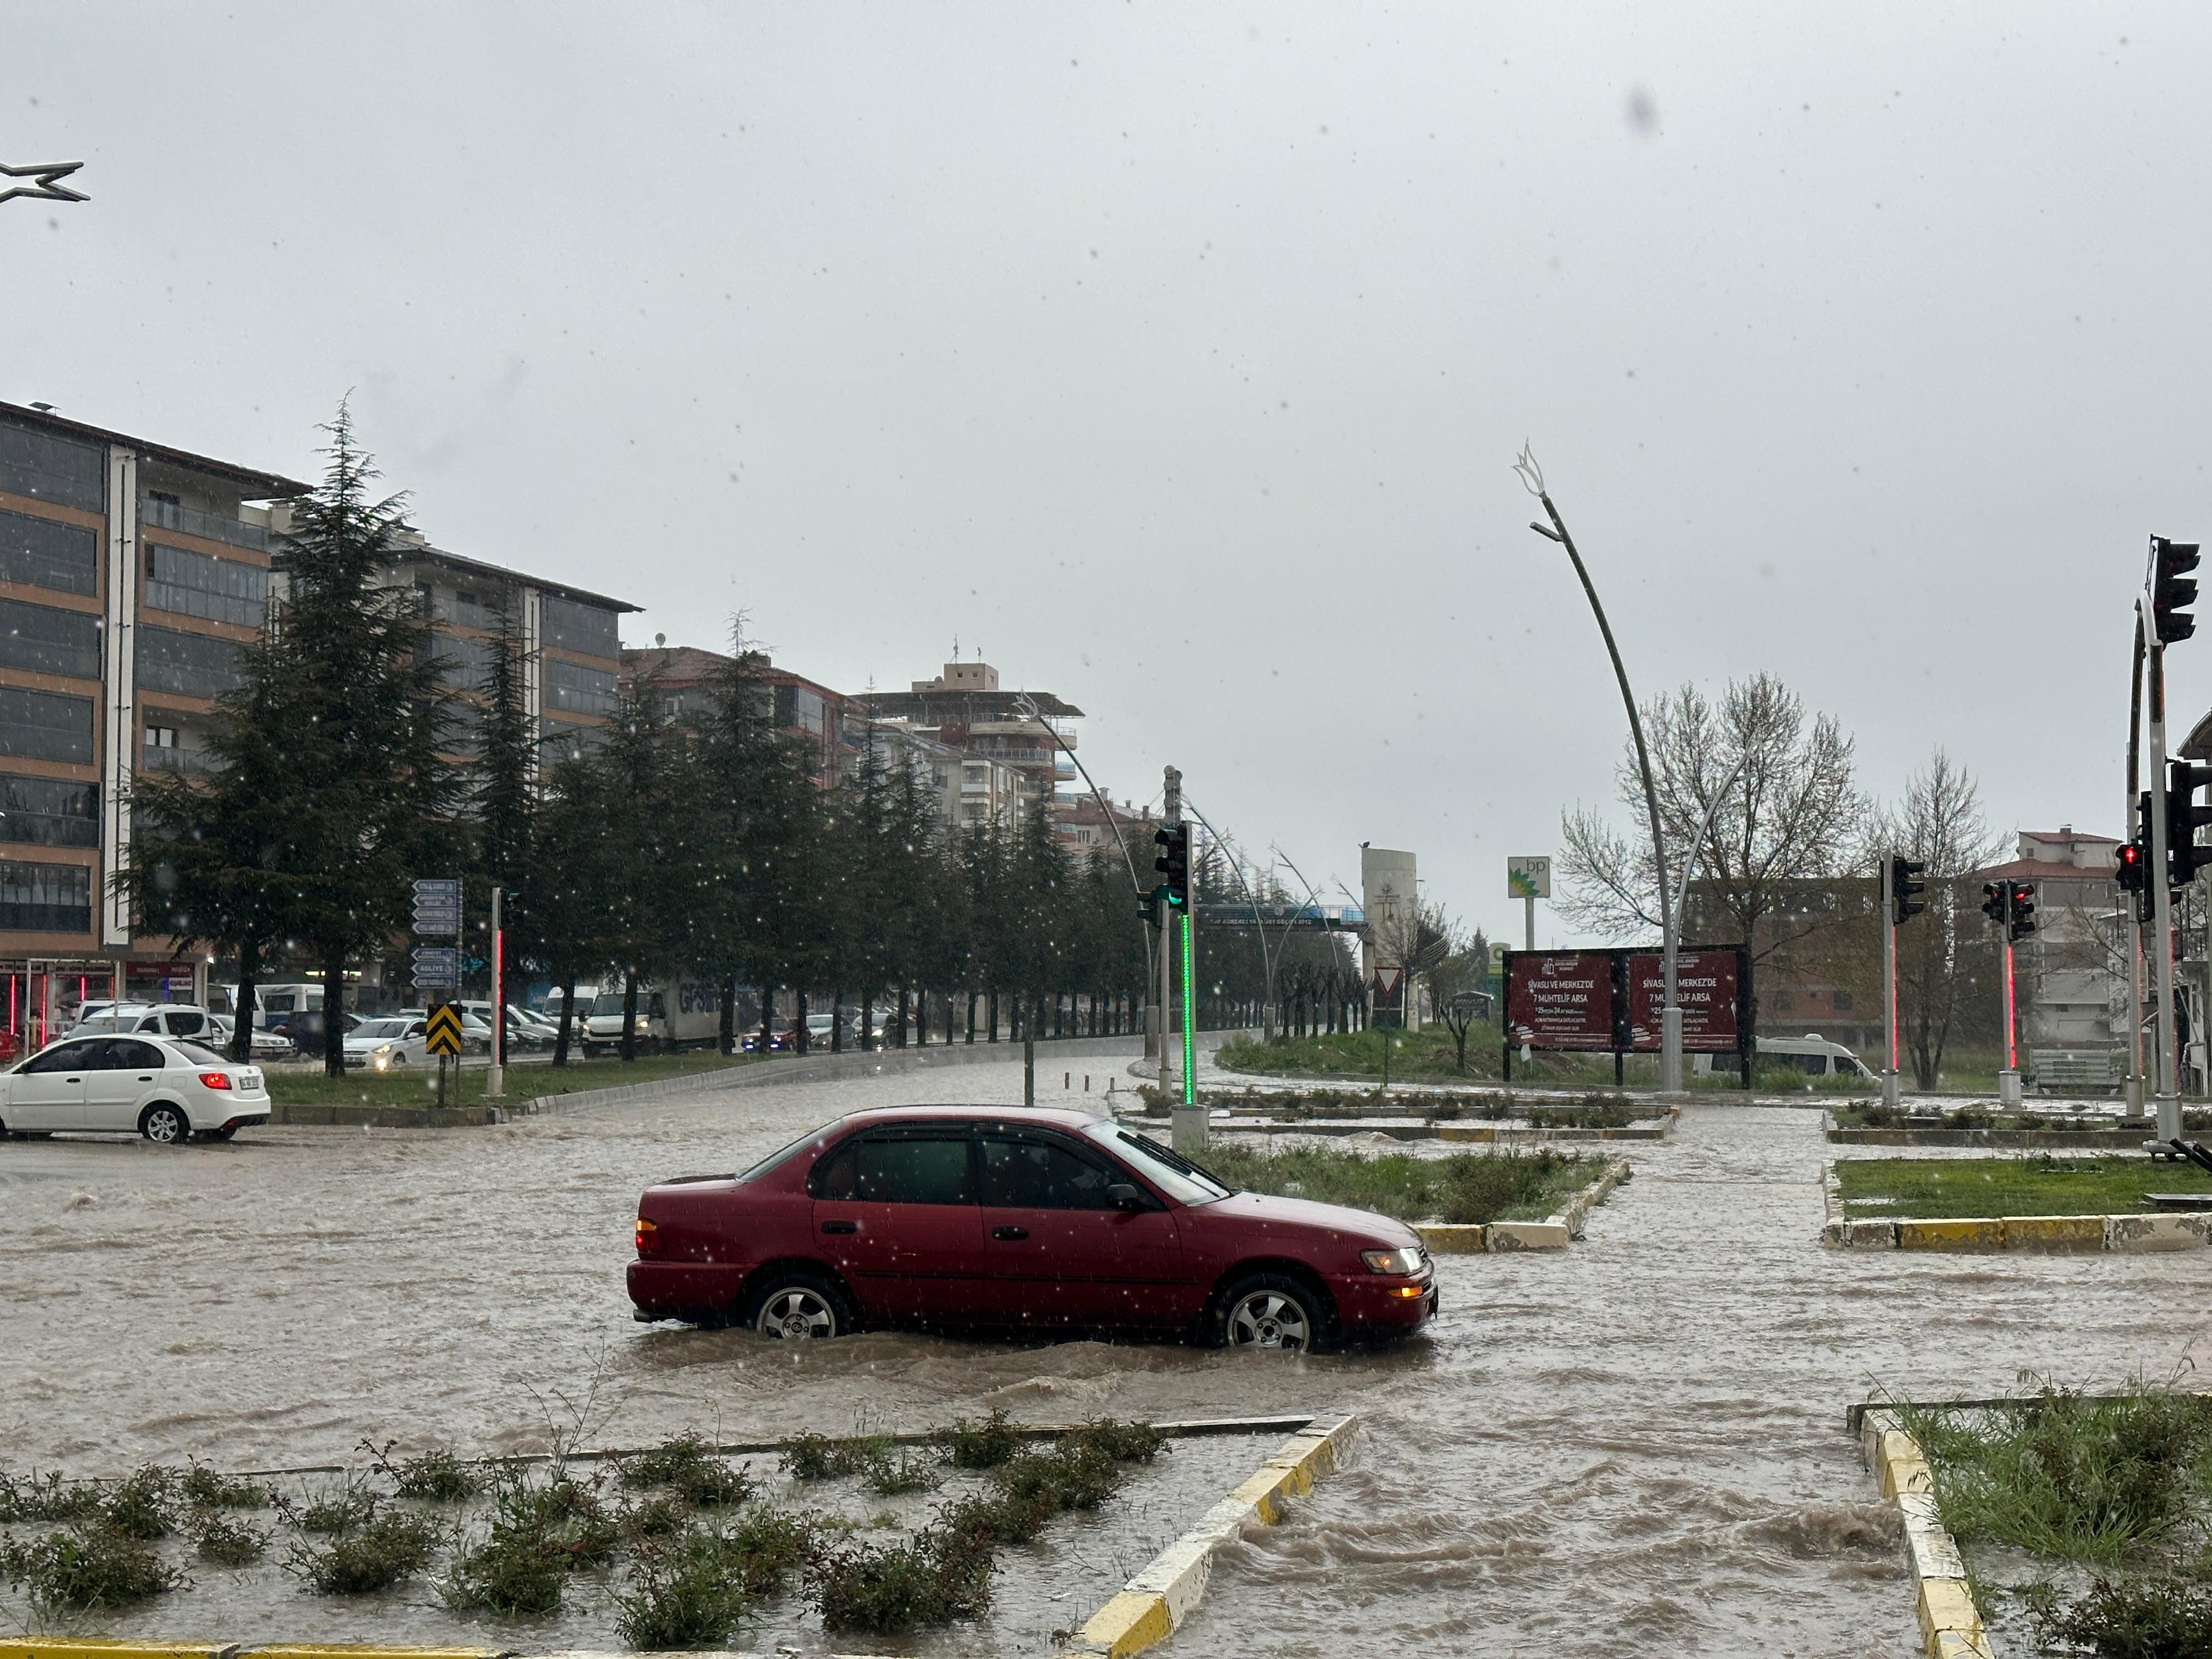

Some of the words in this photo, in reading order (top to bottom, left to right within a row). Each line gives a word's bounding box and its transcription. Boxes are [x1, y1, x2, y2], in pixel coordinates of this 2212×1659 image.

[1526, 859, 1545, 874] bp
[1527, 978, 1550, 989] SİVASLI
[1559, 980, 1594, 988] MERKEZ'DE
[1643, 978, 1666, 988] SİVASL
[1678, 978, 1717, 987] MERKEZ'DE
[1538, 992, 1570, 1002] MUHTELİF
[1571, 994, 1588, 1002] ARSA
[1649, 994, 1653, 1002] 7
[1691, 993, 1711, 1002] ARSA
